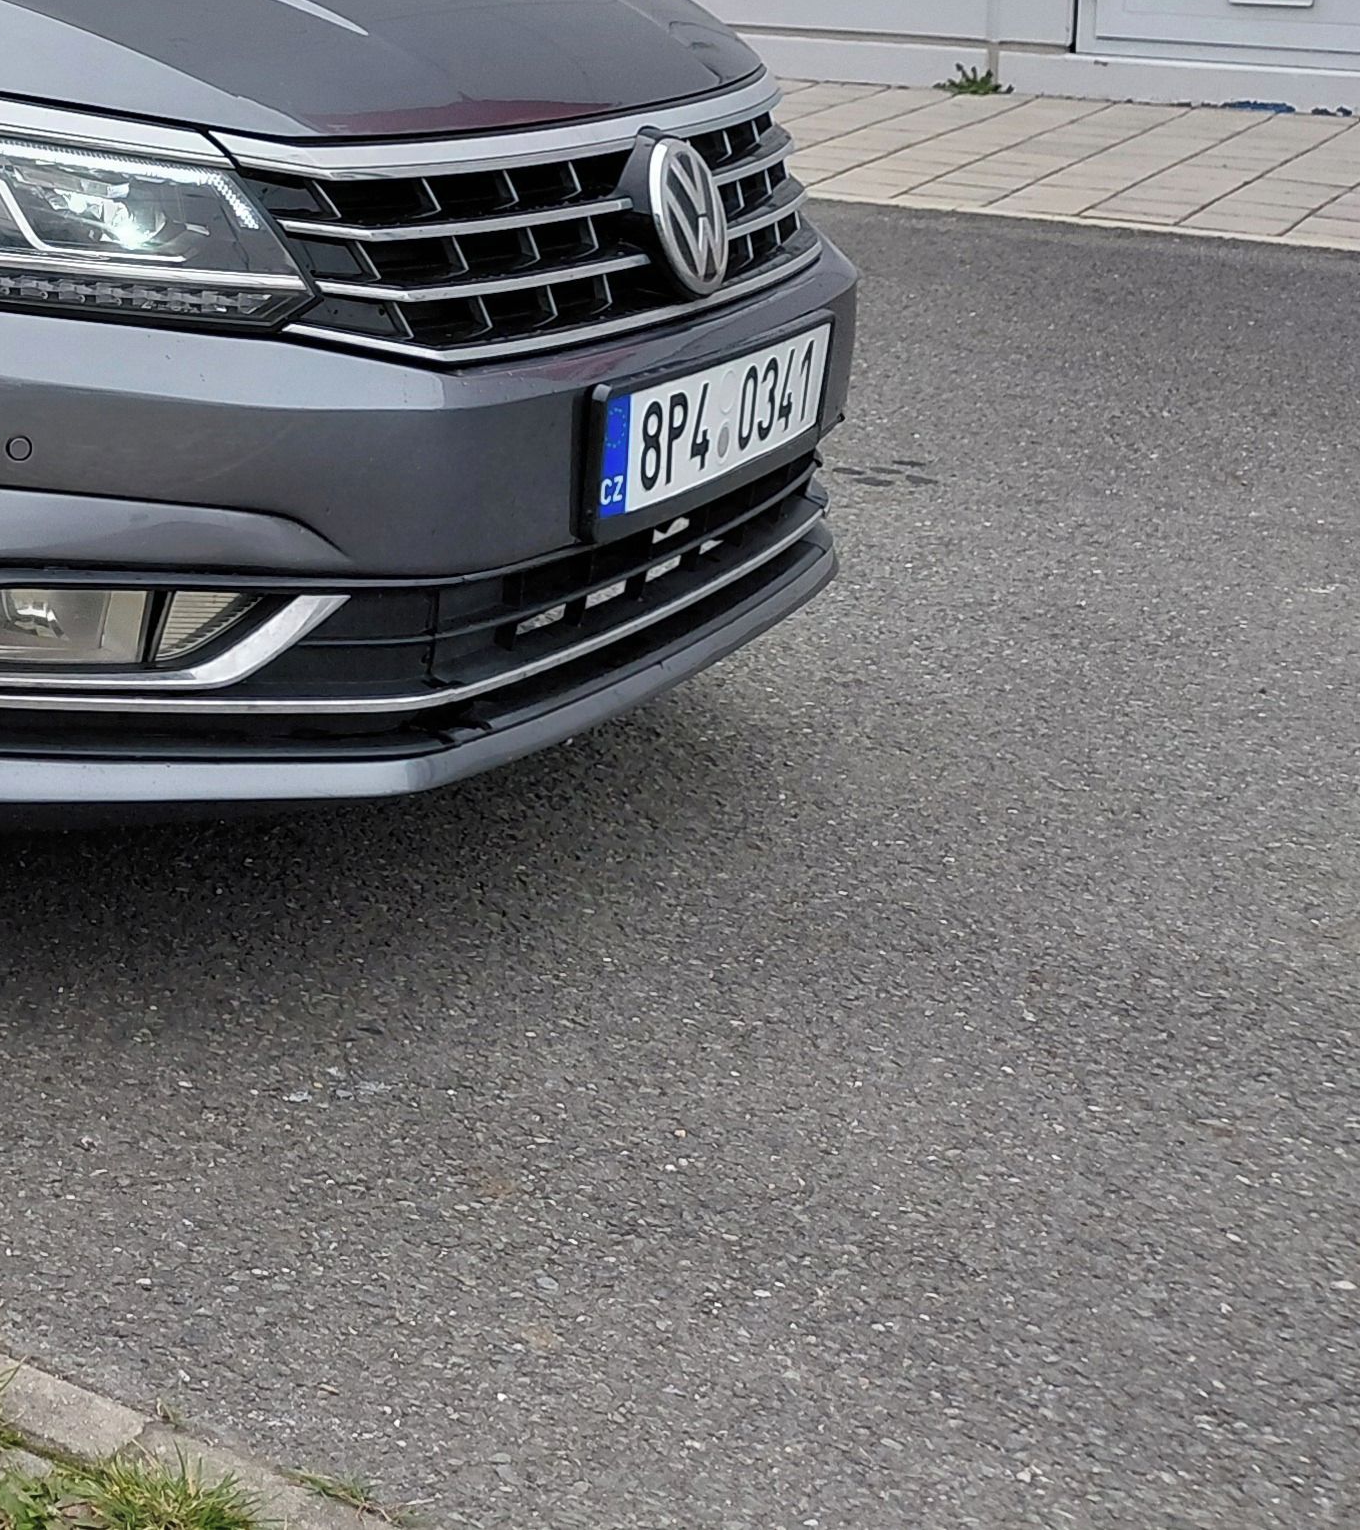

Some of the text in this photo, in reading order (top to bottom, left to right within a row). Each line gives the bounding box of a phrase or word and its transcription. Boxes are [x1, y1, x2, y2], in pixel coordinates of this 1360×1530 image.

[600, 339, 815, 505] CZ 8P4 0341
